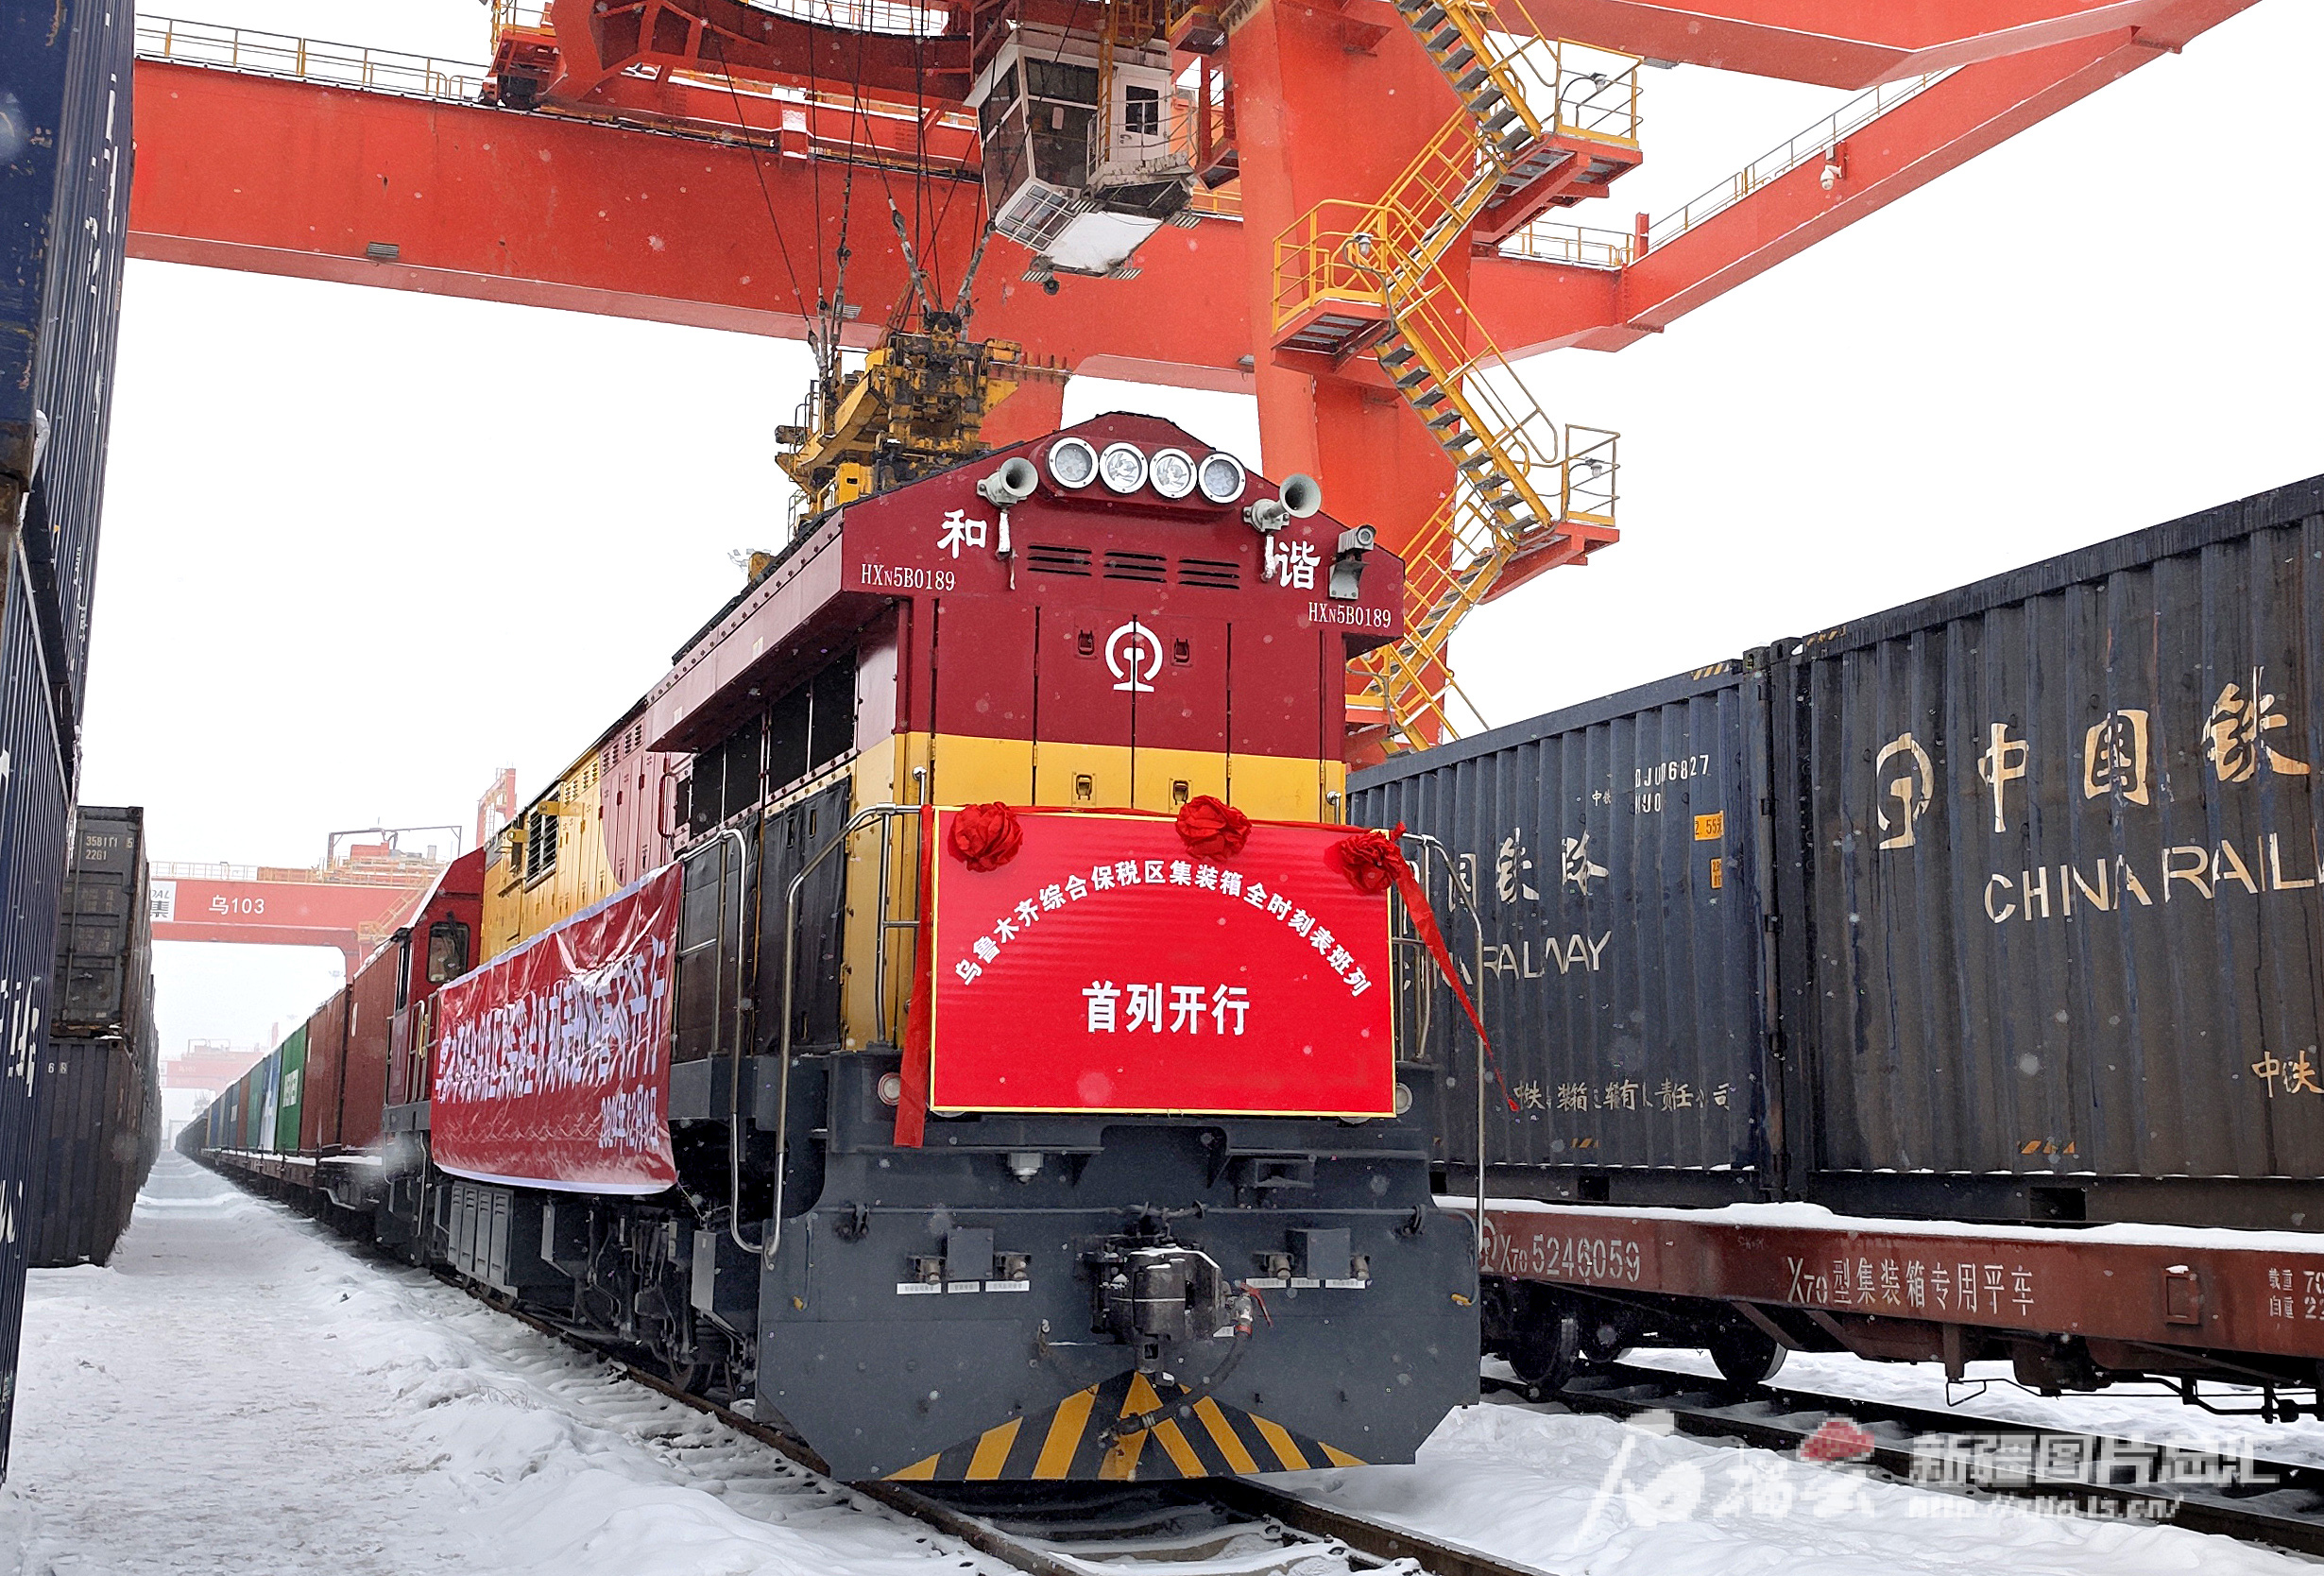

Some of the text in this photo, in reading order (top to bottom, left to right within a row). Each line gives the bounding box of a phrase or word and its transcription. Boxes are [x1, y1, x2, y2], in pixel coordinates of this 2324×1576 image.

[937, 508, 1322, 591] 和 谐
[2161, 824, 2324, 903] RAIL
[208, 894, 265, 916] 乌103
[955, 859, 1372, 997] 乌鲁木齐综合保税区集装箱全时刻表班列
[1082, 980, 1250, 1036] 首列开行
[1532, 1233, 1641, 1283] 5246059
[1787, 1256, 2035, 1316] X70型集装箱专用平车
